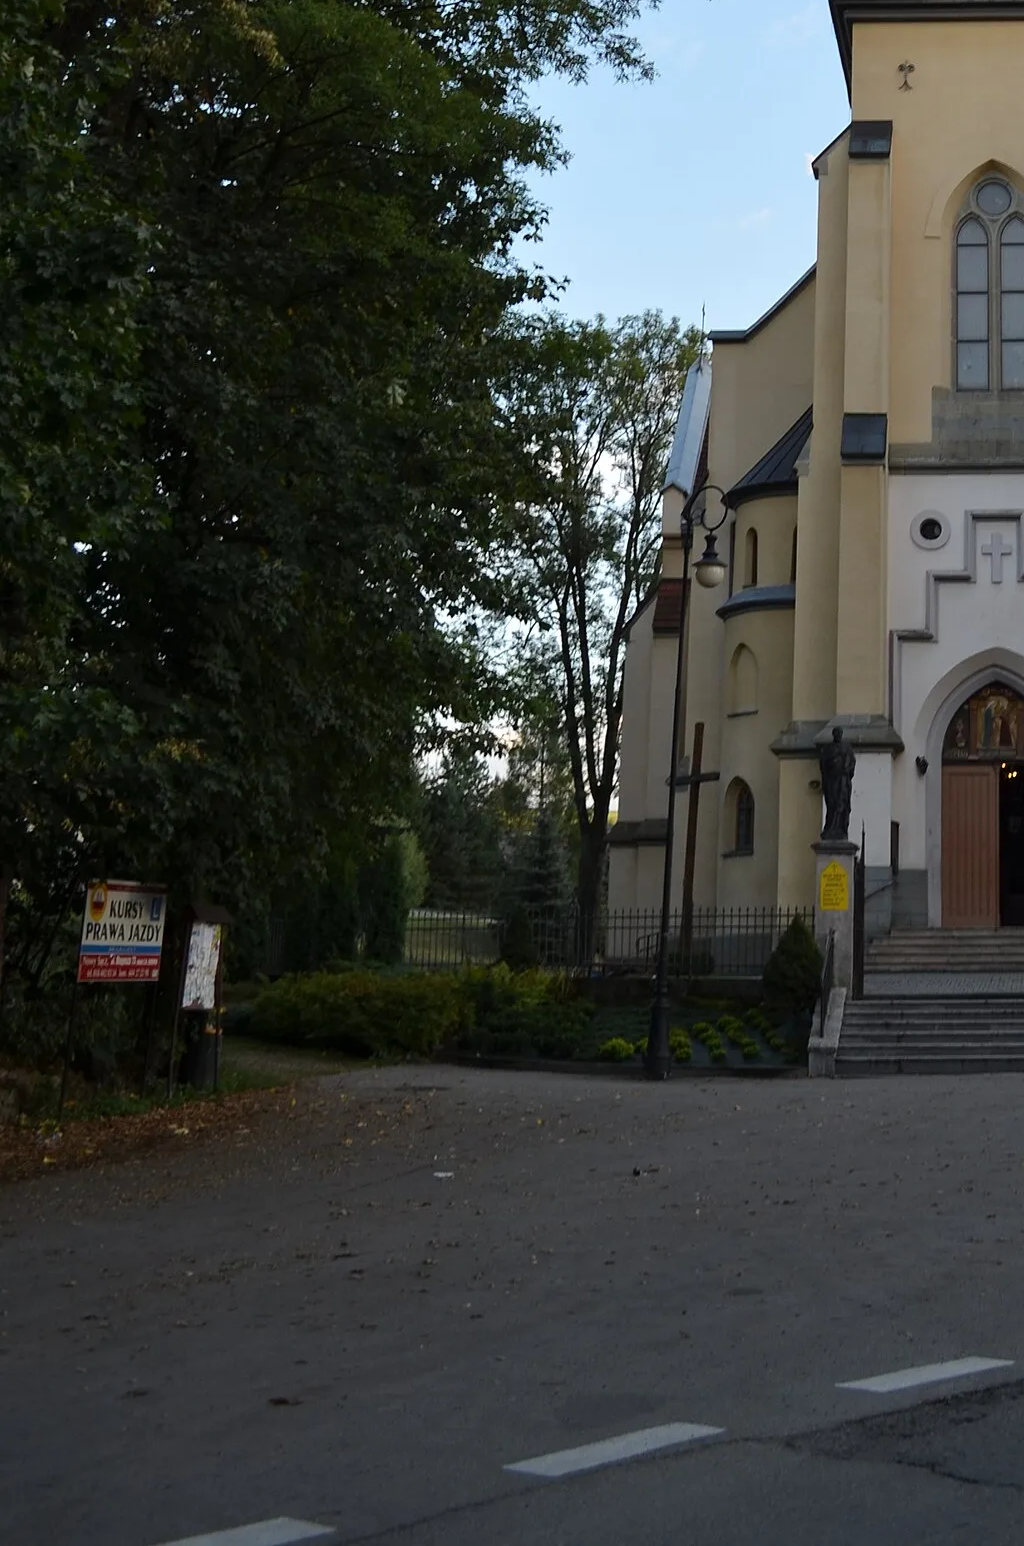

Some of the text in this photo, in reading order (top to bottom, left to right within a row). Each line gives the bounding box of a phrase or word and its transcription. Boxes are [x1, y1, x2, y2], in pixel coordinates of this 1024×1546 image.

[109, 900, 144, 919] KURSY
[85, 922, 161, 942] PRAWA JAZDY
